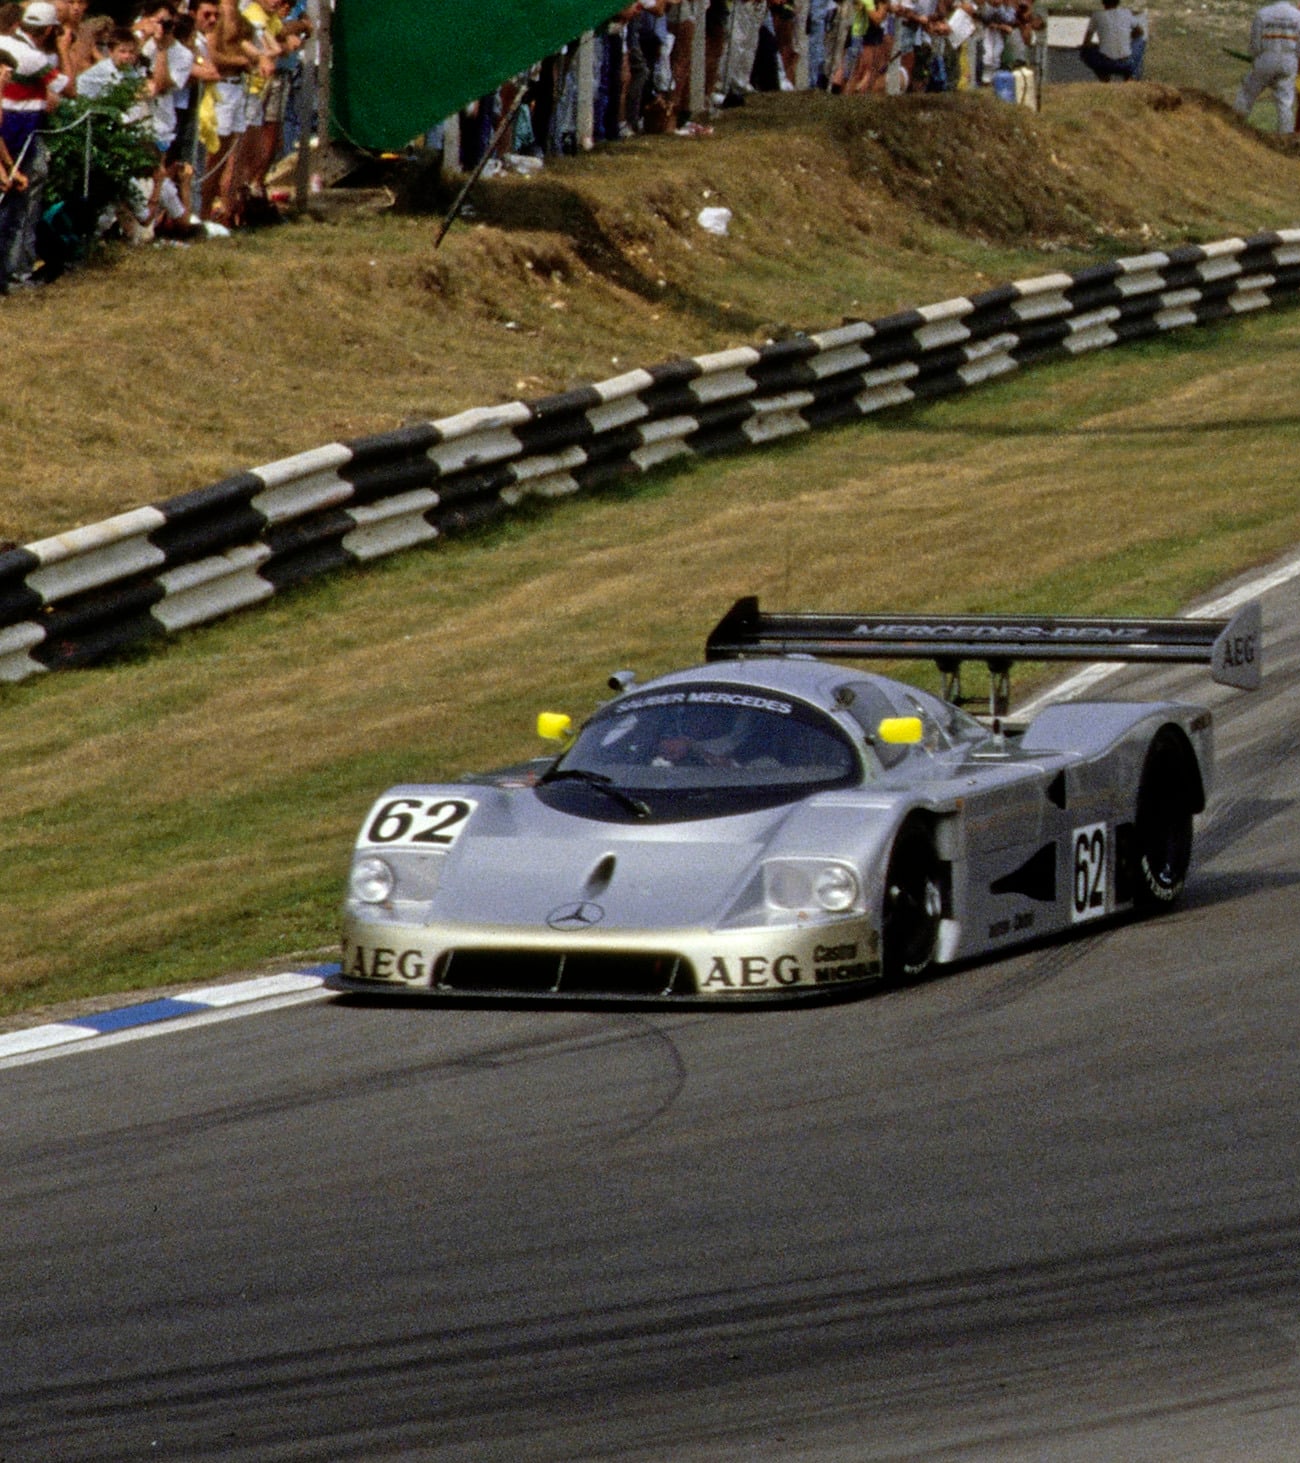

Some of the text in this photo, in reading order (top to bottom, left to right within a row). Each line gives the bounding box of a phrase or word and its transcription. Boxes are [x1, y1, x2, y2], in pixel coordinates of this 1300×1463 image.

[687, 691, 793, 715] MERCEDES
[366, 798, 471, 844] 62
[1074, 828, 1105, 914] 62
[351, 945, 426, 980] AEG
[700, 954, 801, 986] AEG
